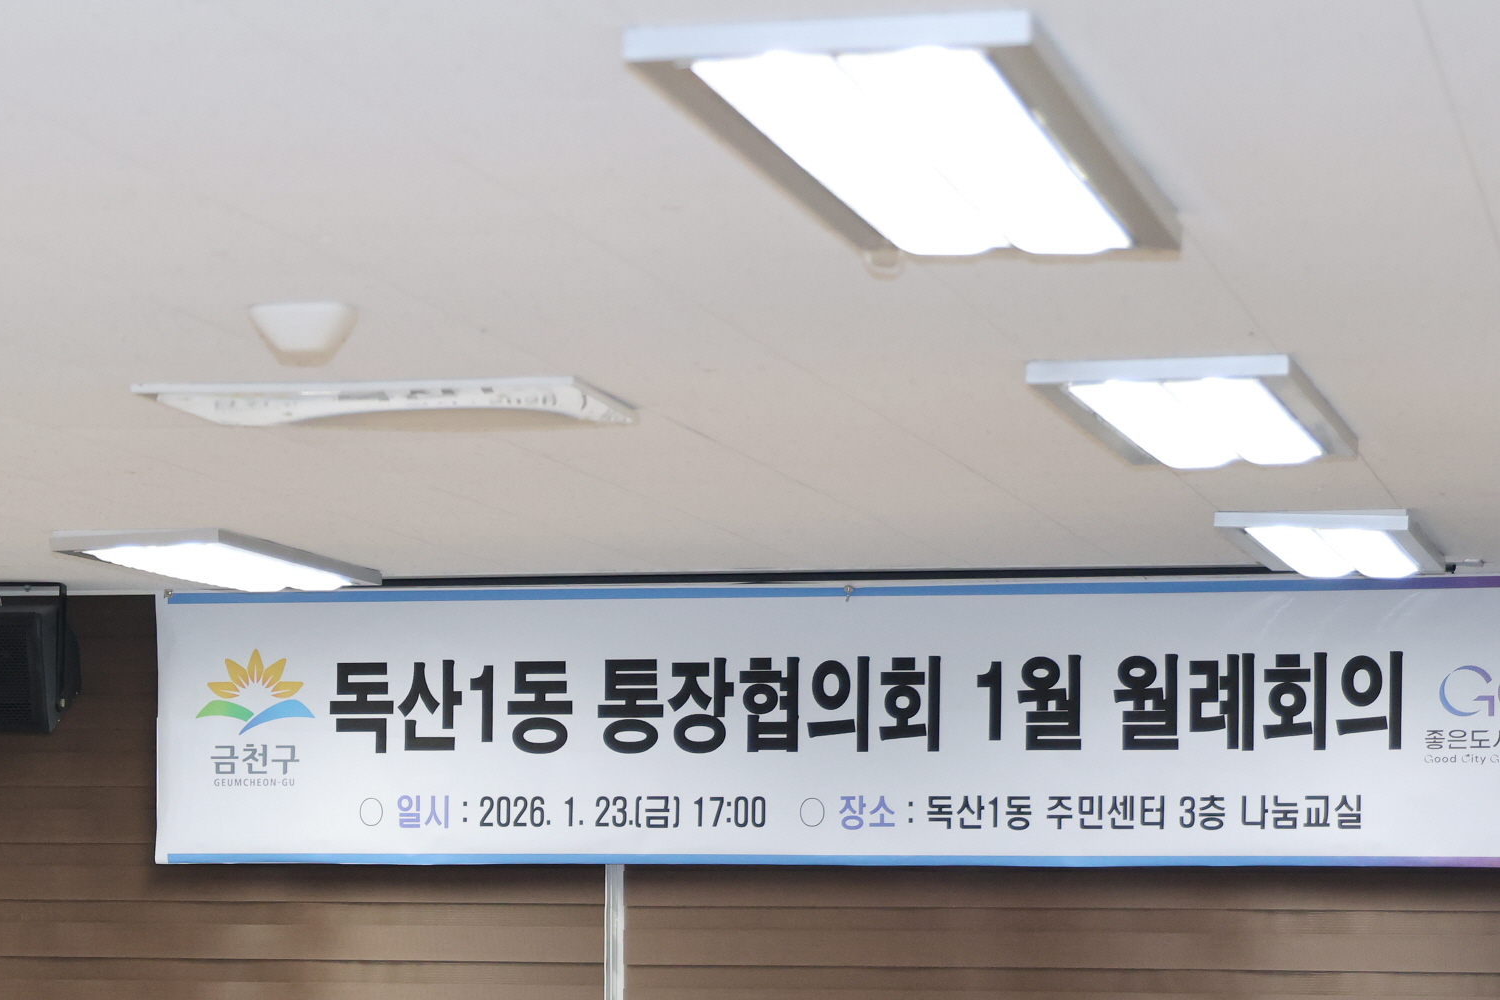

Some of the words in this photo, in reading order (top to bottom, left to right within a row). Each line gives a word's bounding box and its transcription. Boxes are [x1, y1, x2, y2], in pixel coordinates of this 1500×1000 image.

[329, 659, 573, 754] 독산1동
[598, 656, 941, 755] 통장협의회
[977, 654, 1082, 752] 1월
[1113, 650, 1404, 752] 월례회의
[210, 743, 300, 775] 금천구
[1424, 754, 1457, 764] Good
[1461, 754, 1486, 765] City
[213, 778, 296, 788] GEUMCHEON-GU
[396, 795, 450, 829] 일시
[478, 797, 552, 829] 2026.
[563, 797, 584, 829] 1.
[594, 796, 680, 830] 23.(금)
[693, 797, 767, 829] 17:00
[838, 795, 896, 830] 장소
[926, 795, 1033, 831] 독산1동
[1046, 795, 1166, 831] 주민센터
[1179, 795, 1227, 831] 3층
[1241, 794, 1363, 831] 나눔교실
